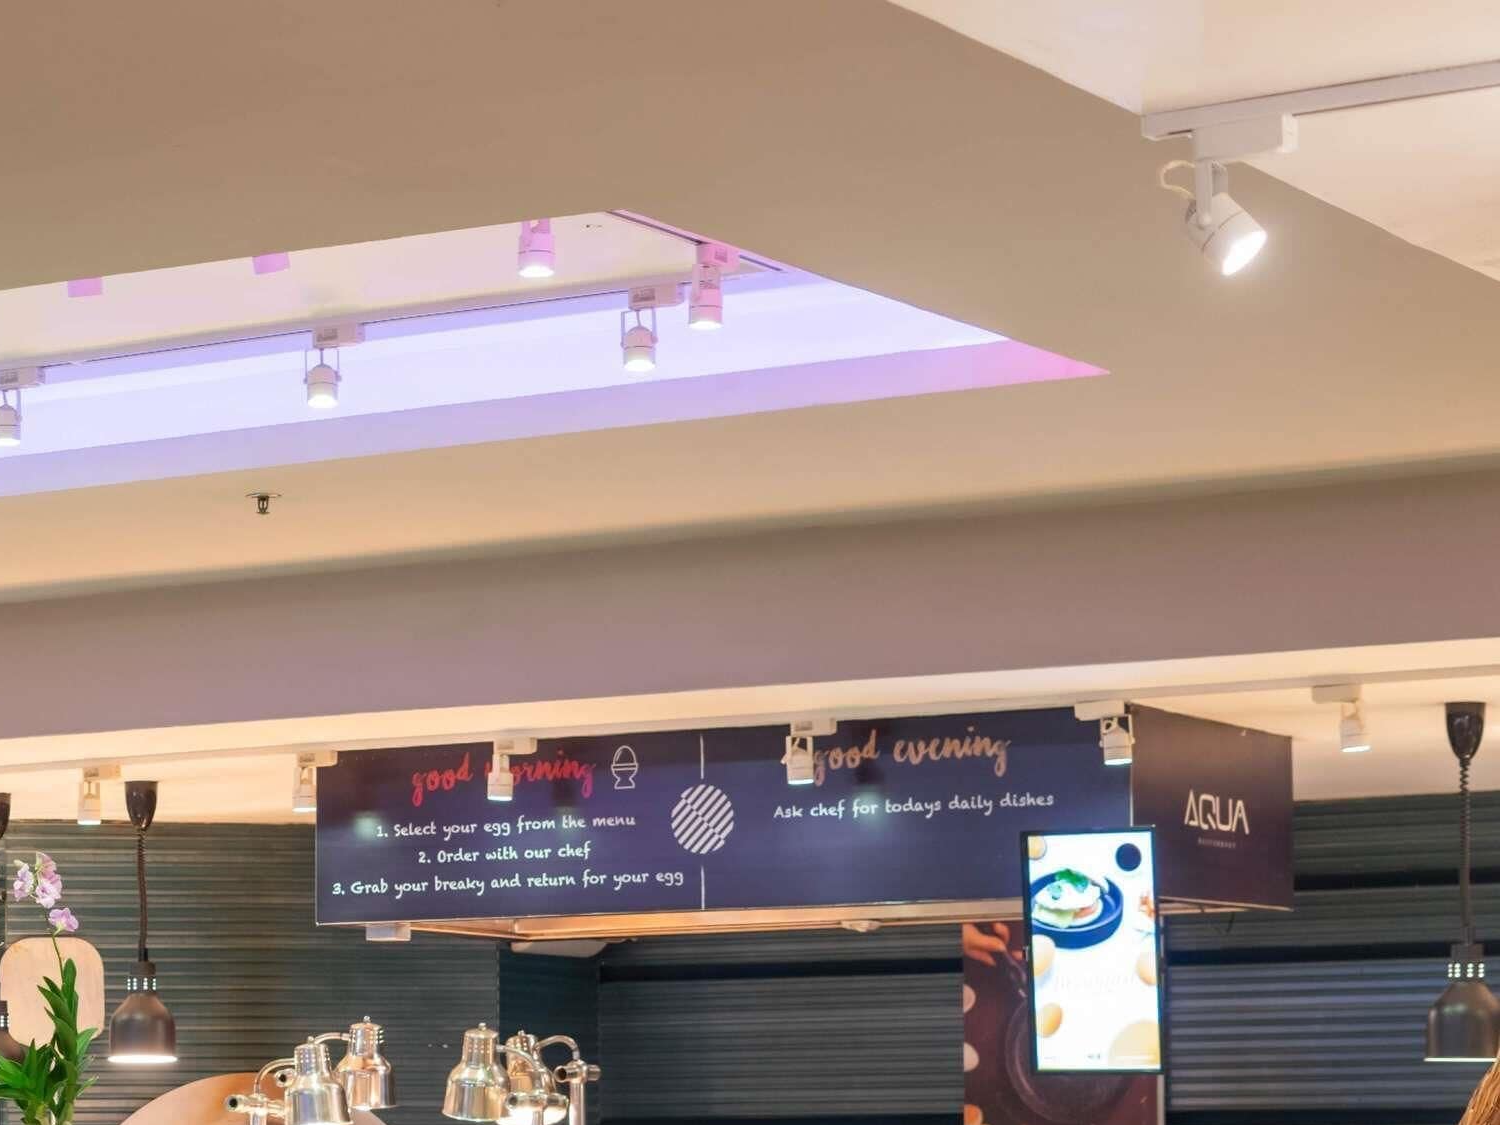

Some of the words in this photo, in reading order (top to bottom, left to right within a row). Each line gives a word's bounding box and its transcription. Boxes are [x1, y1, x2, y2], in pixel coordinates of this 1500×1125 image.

[893, 726, 1011, 777] evening
[411, 752, 473, 807] good
[485, 750, 596, 798] orning
[773, 805, 802, 818] Ask
[810, 800, 845, 819] chef
[852, 798, 878, 818] for
[885, 796, 941, 818] todays
[949, 795, 993, 815] daily
[1000, 792, 1054, 807] dishes
[1184, 789, 1249, 835] AQUA
[376, 825, 389, 837] 1.
[394, 821, 436, 836] Select
[443, 823, 477, 841] your
[484, 822, 510, 836] egg
[517, 815, 555, 834] from
[562, 815, 586, 828] the
[593, 817, 636, 828] menu
[418, 851, 431, 863] 2.
[437, 848, 479, 863] Order
[485, 846, 518, 860] with
[524, 848, 551, 859] our
[558, 841, 591, 859] chef
[332, 883, 345, 895] 3.
[351, 878, 388, 894] Grab
[395, 881, 428, 899] your
[435, 876, 484, 896] breaky
[491, 874, 521, 889] and
[528, 873, 575, 888] return
[583, 869, 606, 888] for
[614, 872, 648, 890] your
[656, 872, 684, 886] egg
